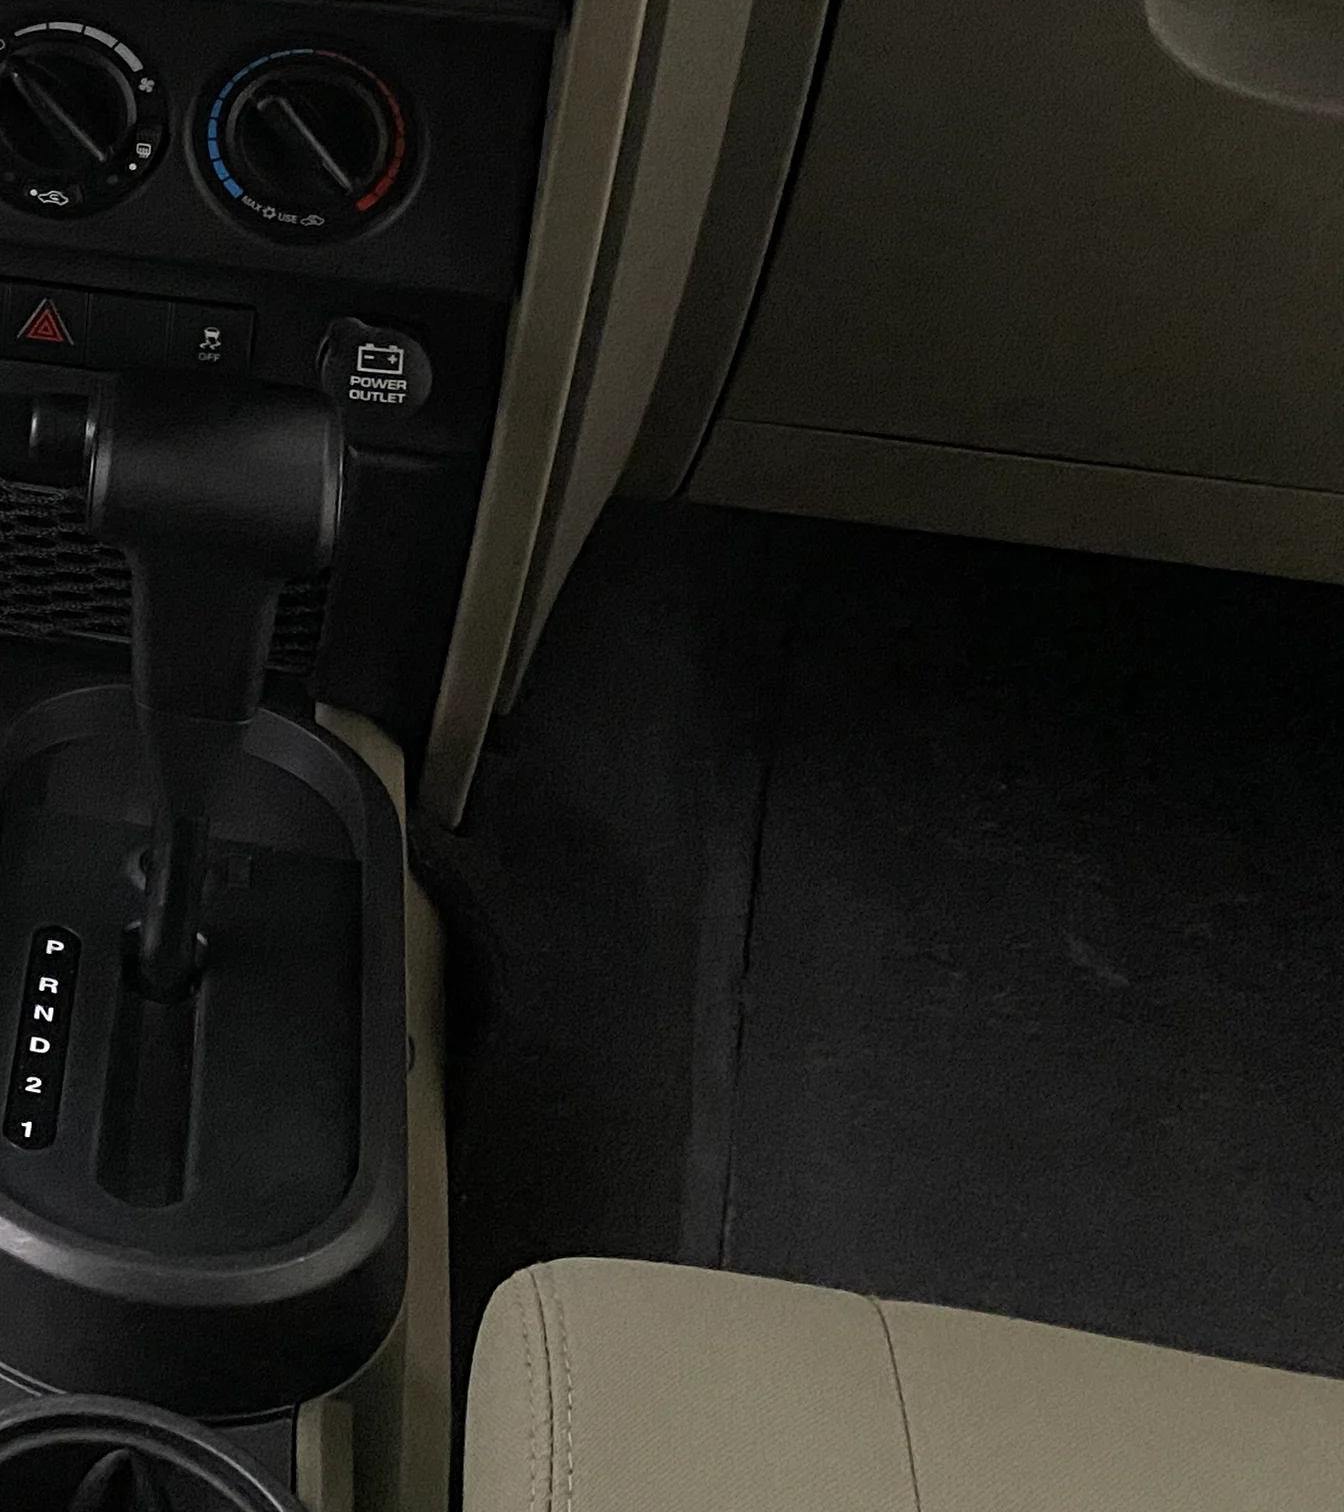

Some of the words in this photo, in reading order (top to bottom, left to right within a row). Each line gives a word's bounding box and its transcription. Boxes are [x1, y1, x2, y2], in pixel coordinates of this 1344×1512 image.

[241, 195, 263, 212] MAX
[278, 213, 297, 224] USE
[198, 352, 220, 362] OFF
[349, 375, 407, 391] POWER
[348, 389, 407, 404] OUTLET
[45, 939, 65, 955] P
[38, 976, 59, 994] R
[33, 1004, 54, 1022] N
[29, 1036, 51, 1054] D
[24, 1076, 42, 1094] 2
[20, 1121, 33, 1138] 1
